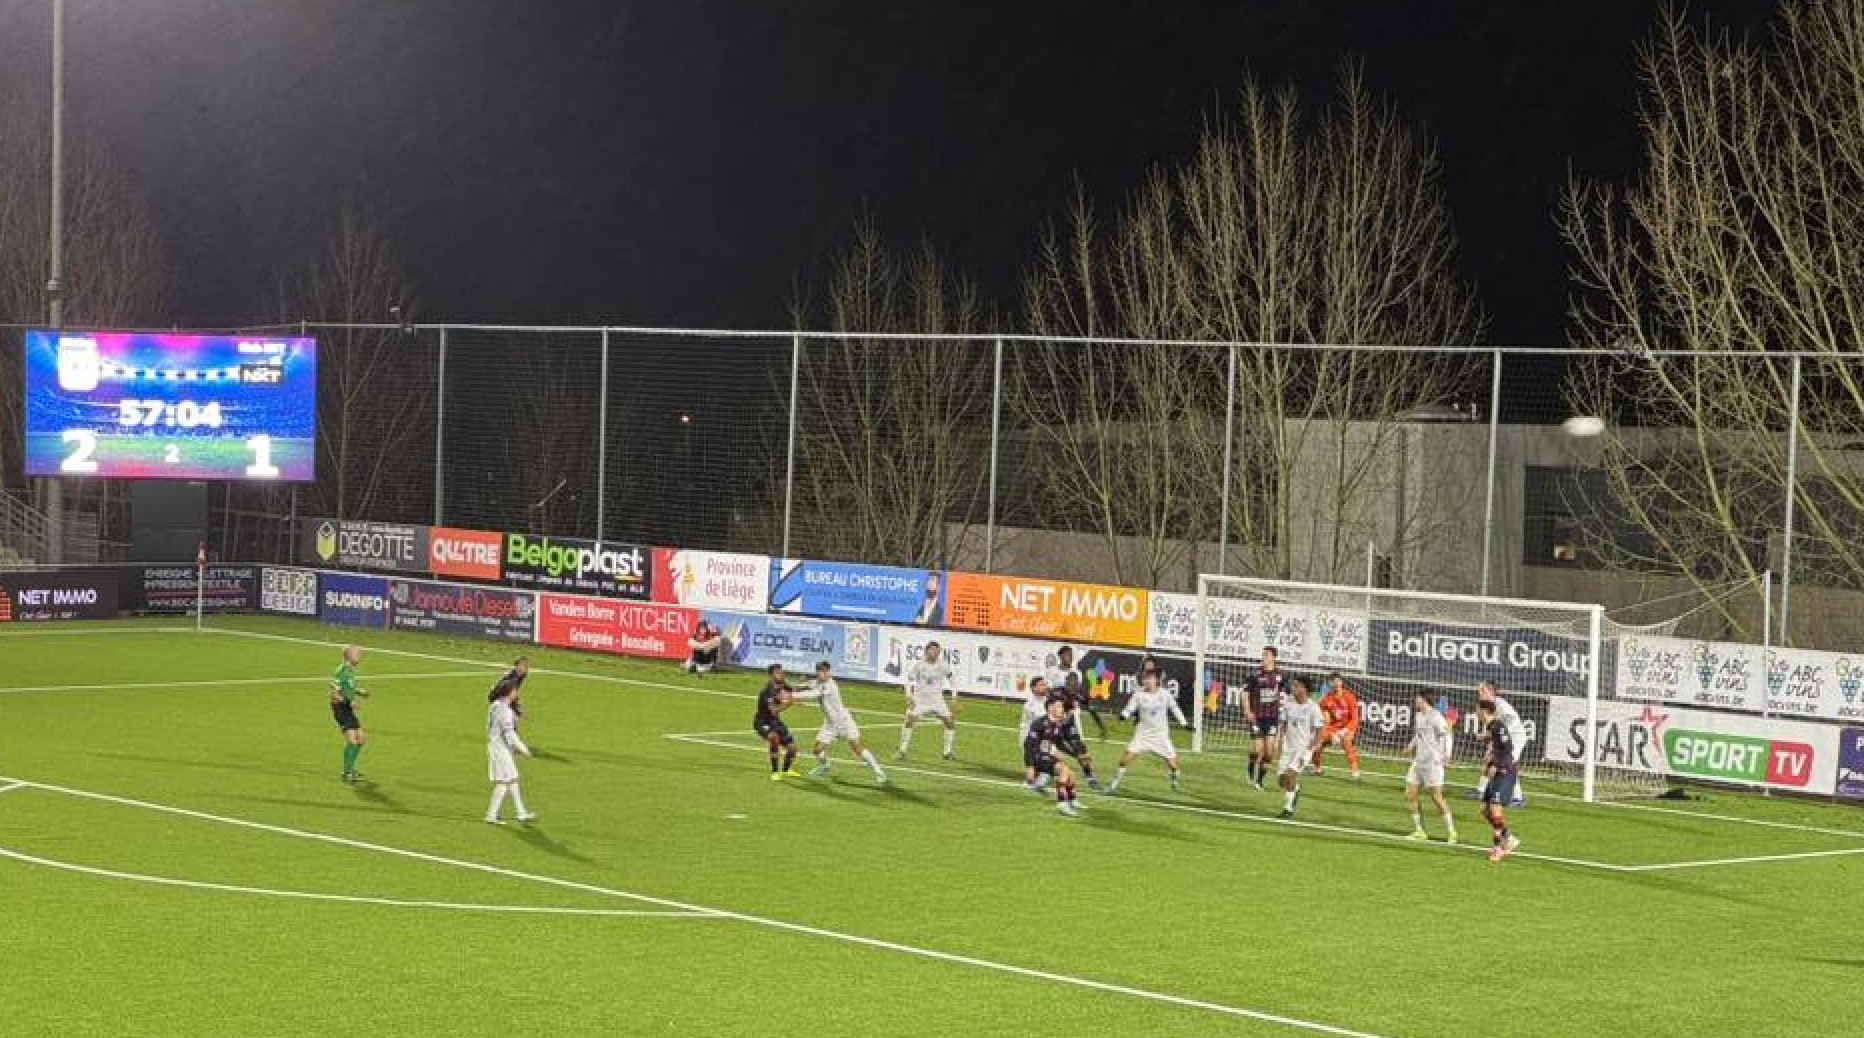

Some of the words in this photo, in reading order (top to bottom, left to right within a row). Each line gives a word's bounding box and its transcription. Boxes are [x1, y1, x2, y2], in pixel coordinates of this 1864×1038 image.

[119, 399, 222, 427] 57:04
[60, 429, 99, 472] 2
[165, 445, 181, 463] 2
[245, 434, 279, 477] 1
[340, 532, 415, 560] DEGOTTE
[508, 534, 644, 578] Belgoplast
[708, 558, 756, 577] Province
[705, 579, 720, 596] de
[721, 579, 755, 604] Liège
[805, 570, 847, 586] BUREAU
[849, 573, 919, 593] CHRISTOPHE
[18, 589, 51, 605] NET
[53, 588, 97, 605] IMMO
[325, 590, 383, 611] SUDINFO
[1001, 583, 1056, 613] NET
[1061, 588, 1138, 622] IMMO
[550, 599, 585, 617] Vanden
[587, 602, 615, 621] Borre
[619, 605, 689, 633] KITCHEN
[1172, 606, 1196, 622] ABC
[1225, 612, 1250, 629] ABC
[1222, 628, 1249, 642] vins
[1281, 617, 1307, 634] ABC
[1338, 622, 1364, 639] ABC
[569, 627, 613, 648] Grivegnée
[753, 631, 793, 649] COOL
[799, 637, 835, 655] SUN
[1508, 641, 1591, 681] Group
[1650, 651, 1682, 671] ABC
[1718, 658, 1750, 678] ABC
[1646, 669, 1680, 686] vins
[1715, 675, 1749, 692] vins
[1788, 664, 1822, 684] ABC
[1118, 672, 1180, 698] ma
[1785, 682, 1821, 700] vins
[1694, 693, 1744, 707] abcvins.be
[1568, 717, 1651, 769] STAR
[1671, 736, 1764, 775] SPORT
[1774, 751, 1807, 778] TV
